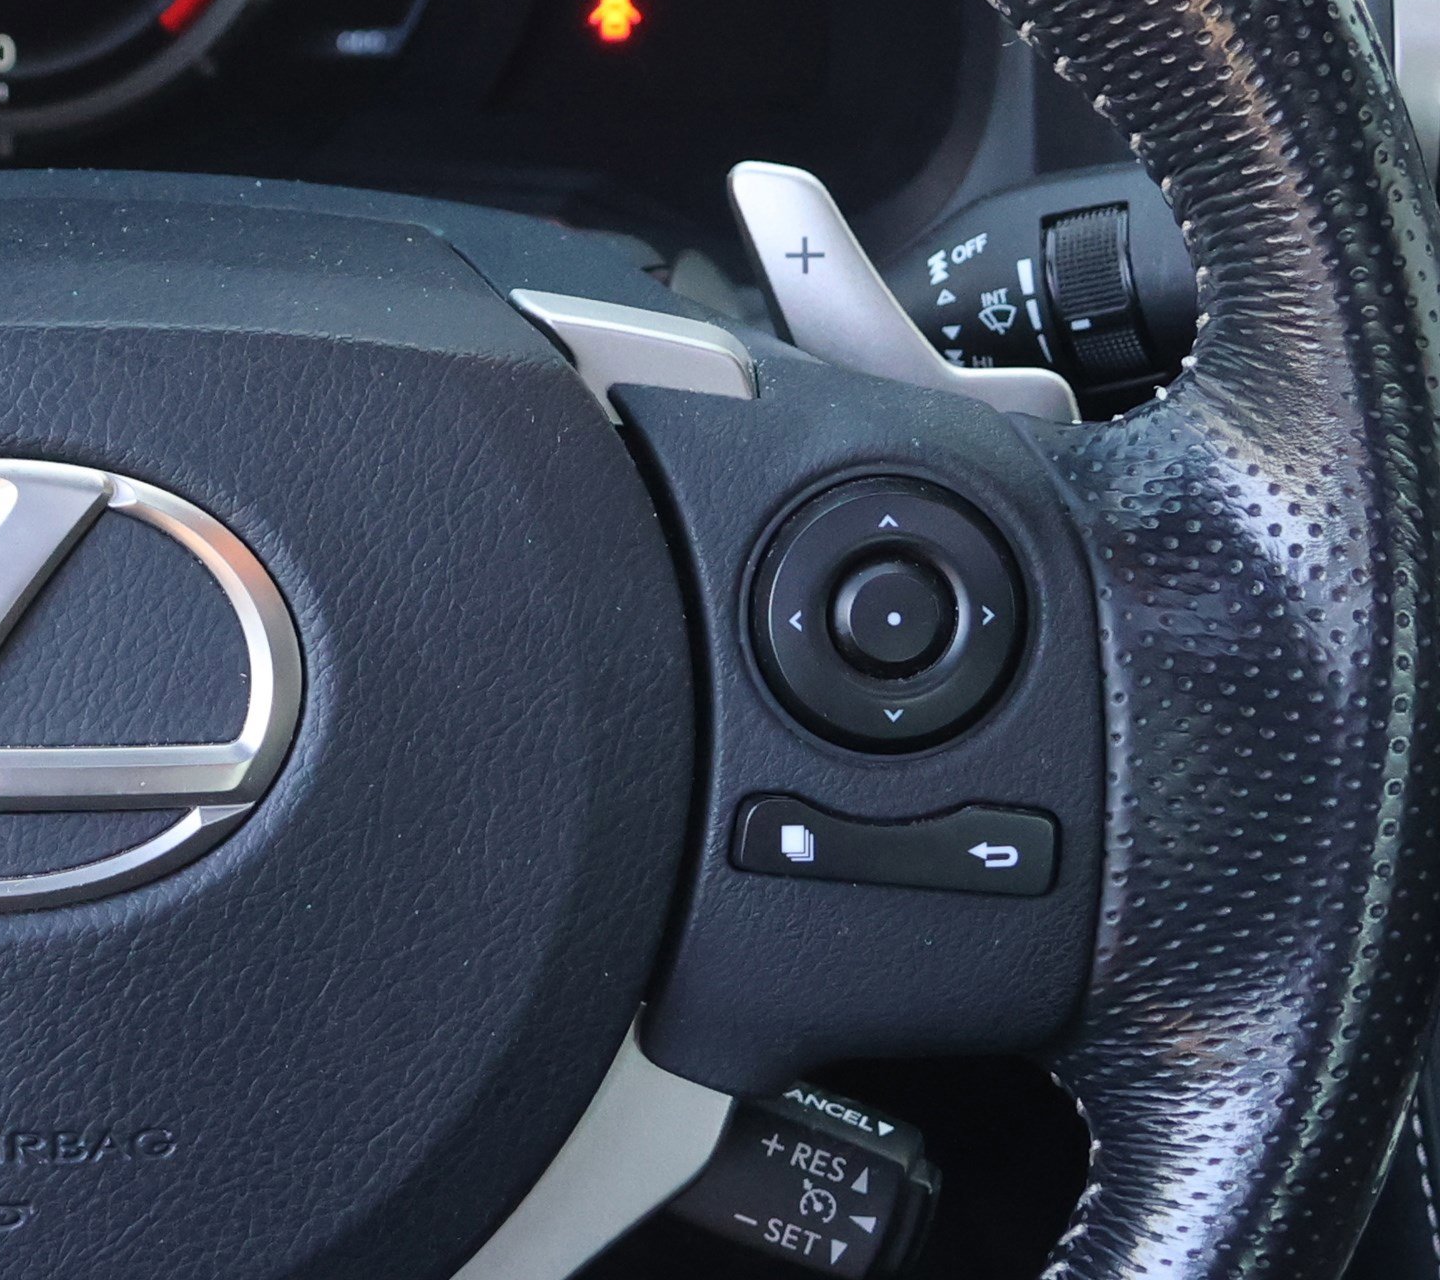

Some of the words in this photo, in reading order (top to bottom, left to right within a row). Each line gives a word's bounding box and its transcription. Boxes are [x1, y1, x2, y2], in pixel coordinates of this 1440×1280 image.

[951, 232, 988, 264] OFF
[980, 287, 1009, 308] INT
[782, 1088, 874, 1133] ANCEL
[789, 1141, 848, 1183] RES
[763, 1217, 822, 1257] SET
